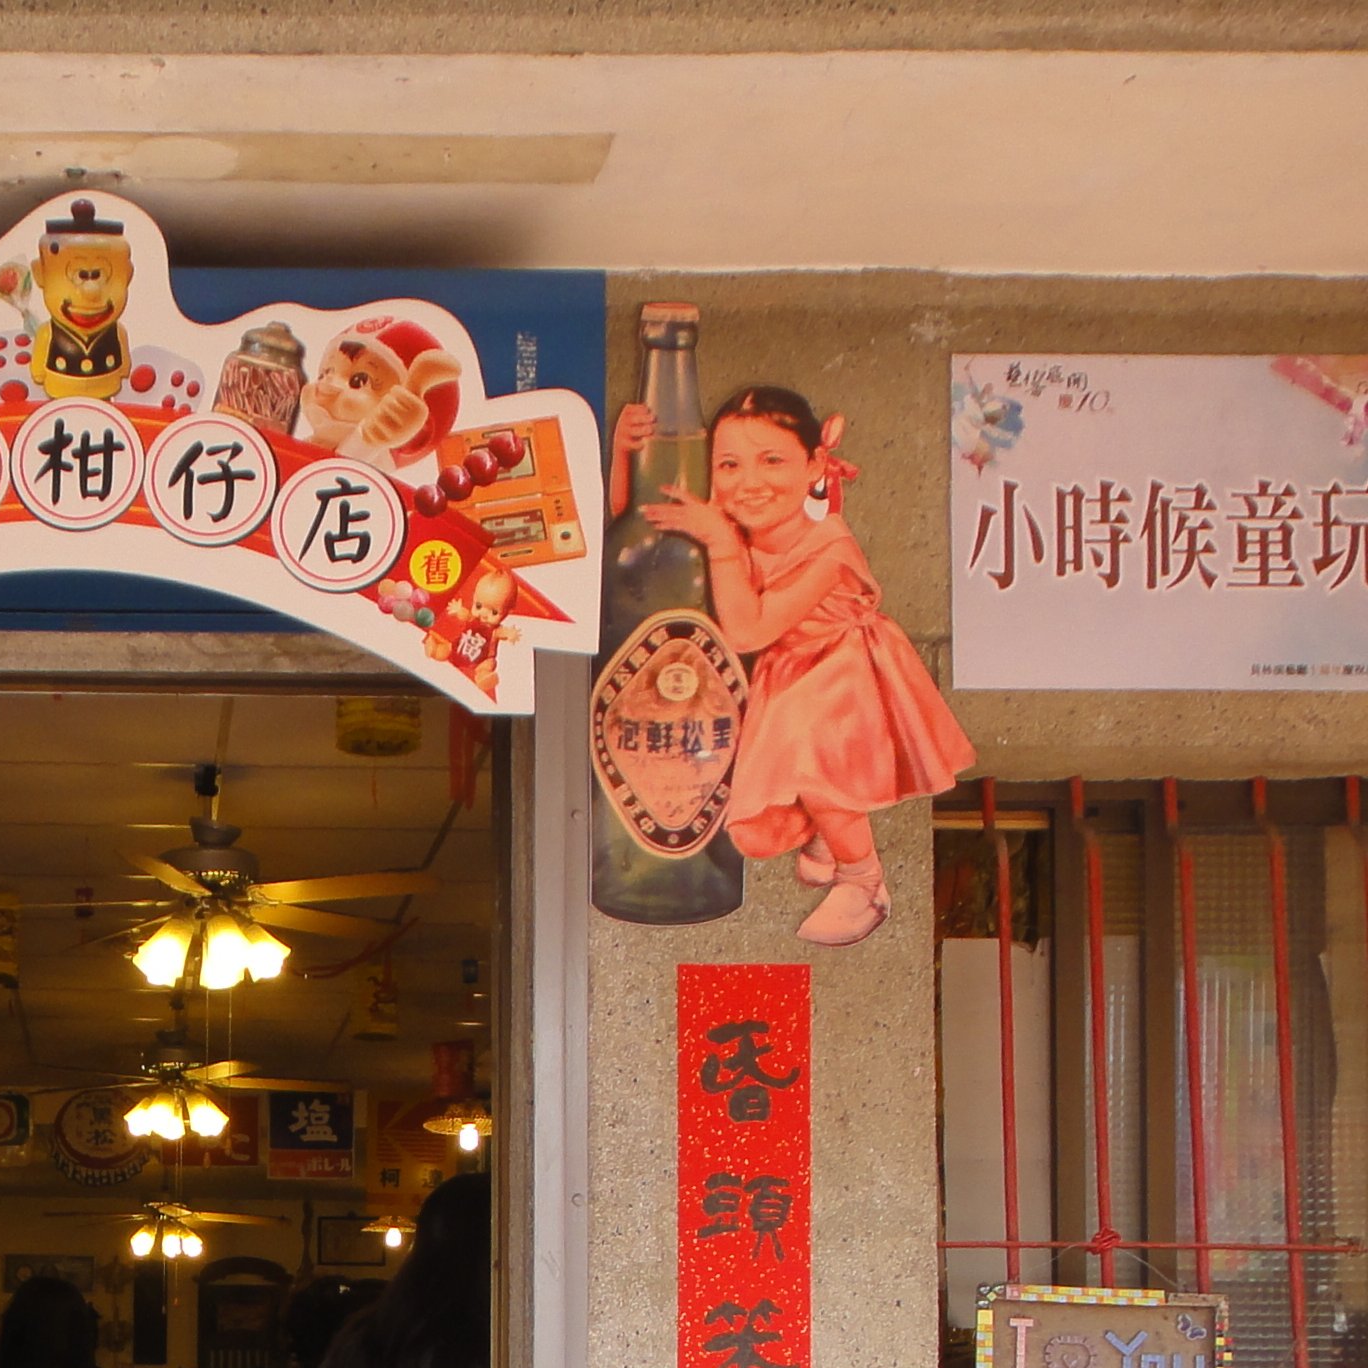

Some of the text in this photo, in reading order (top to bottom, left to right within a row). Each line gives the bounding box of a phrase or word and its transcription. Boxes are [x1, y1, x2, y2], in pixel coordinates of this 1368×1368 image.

[969, 480, 1368, 590] 小時候童玩
[422, 547, 454, 588] 舊
[288, 1099, 338, 1142] 塩
